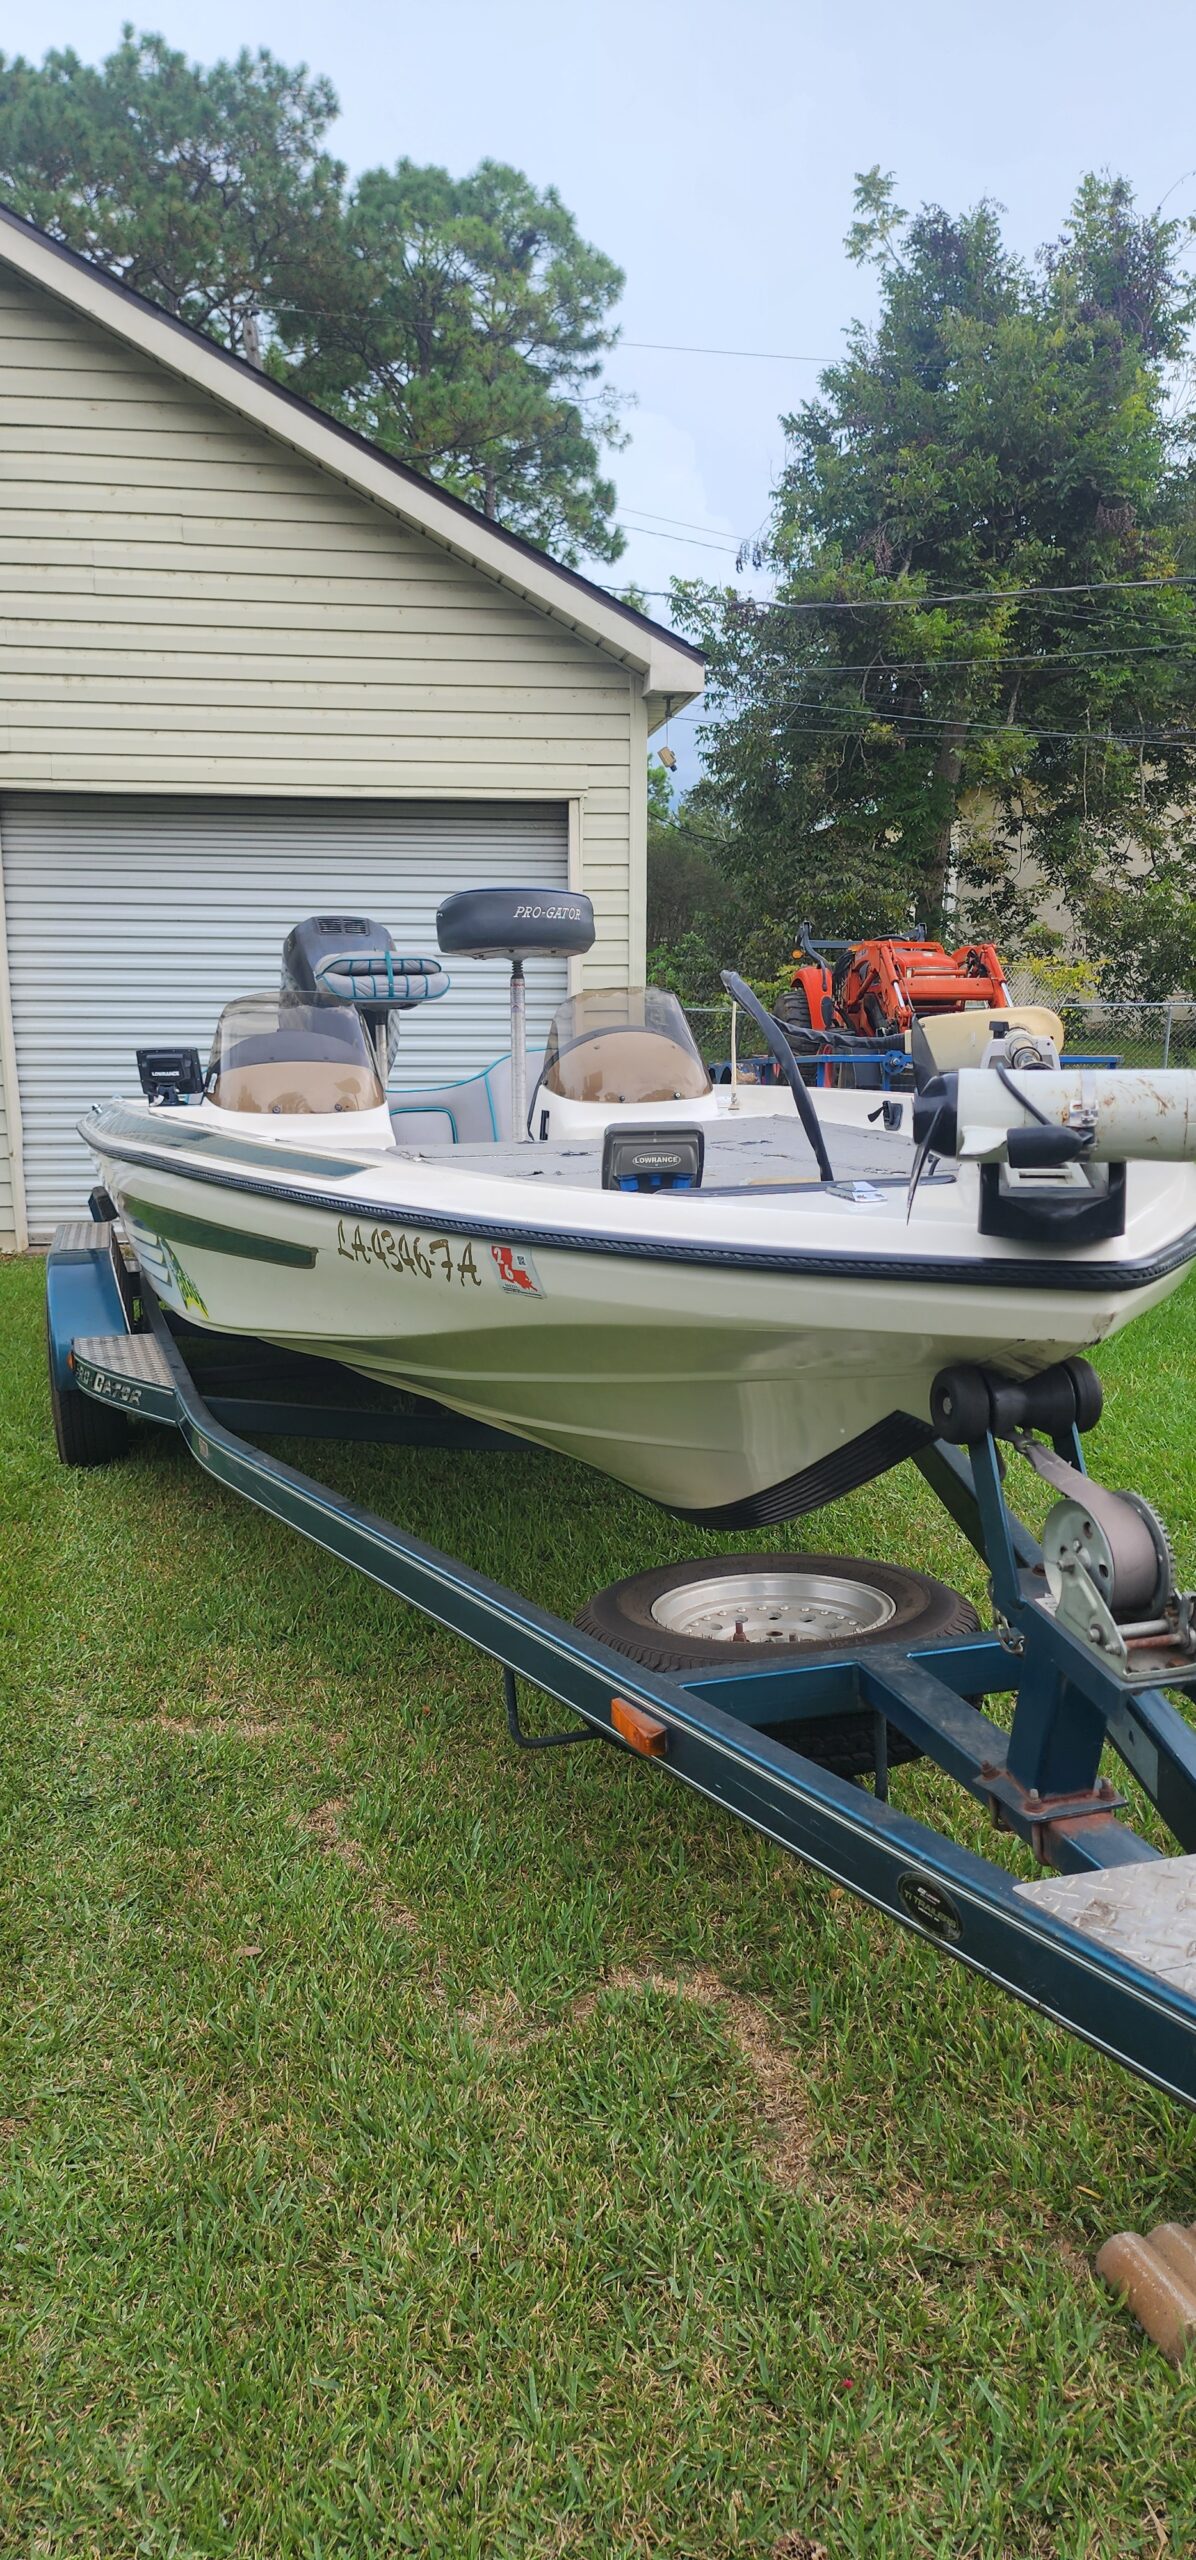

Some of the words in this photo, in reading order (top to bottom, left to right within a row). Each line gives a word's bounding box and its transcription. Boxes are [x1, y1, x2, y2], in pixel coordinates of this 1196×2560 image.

[513, 906, 581, 920] PRO-GATOR
[634, 1156, 678, 1164] LOWRANCE
[93, 1373, 142, 1405] GATOR
